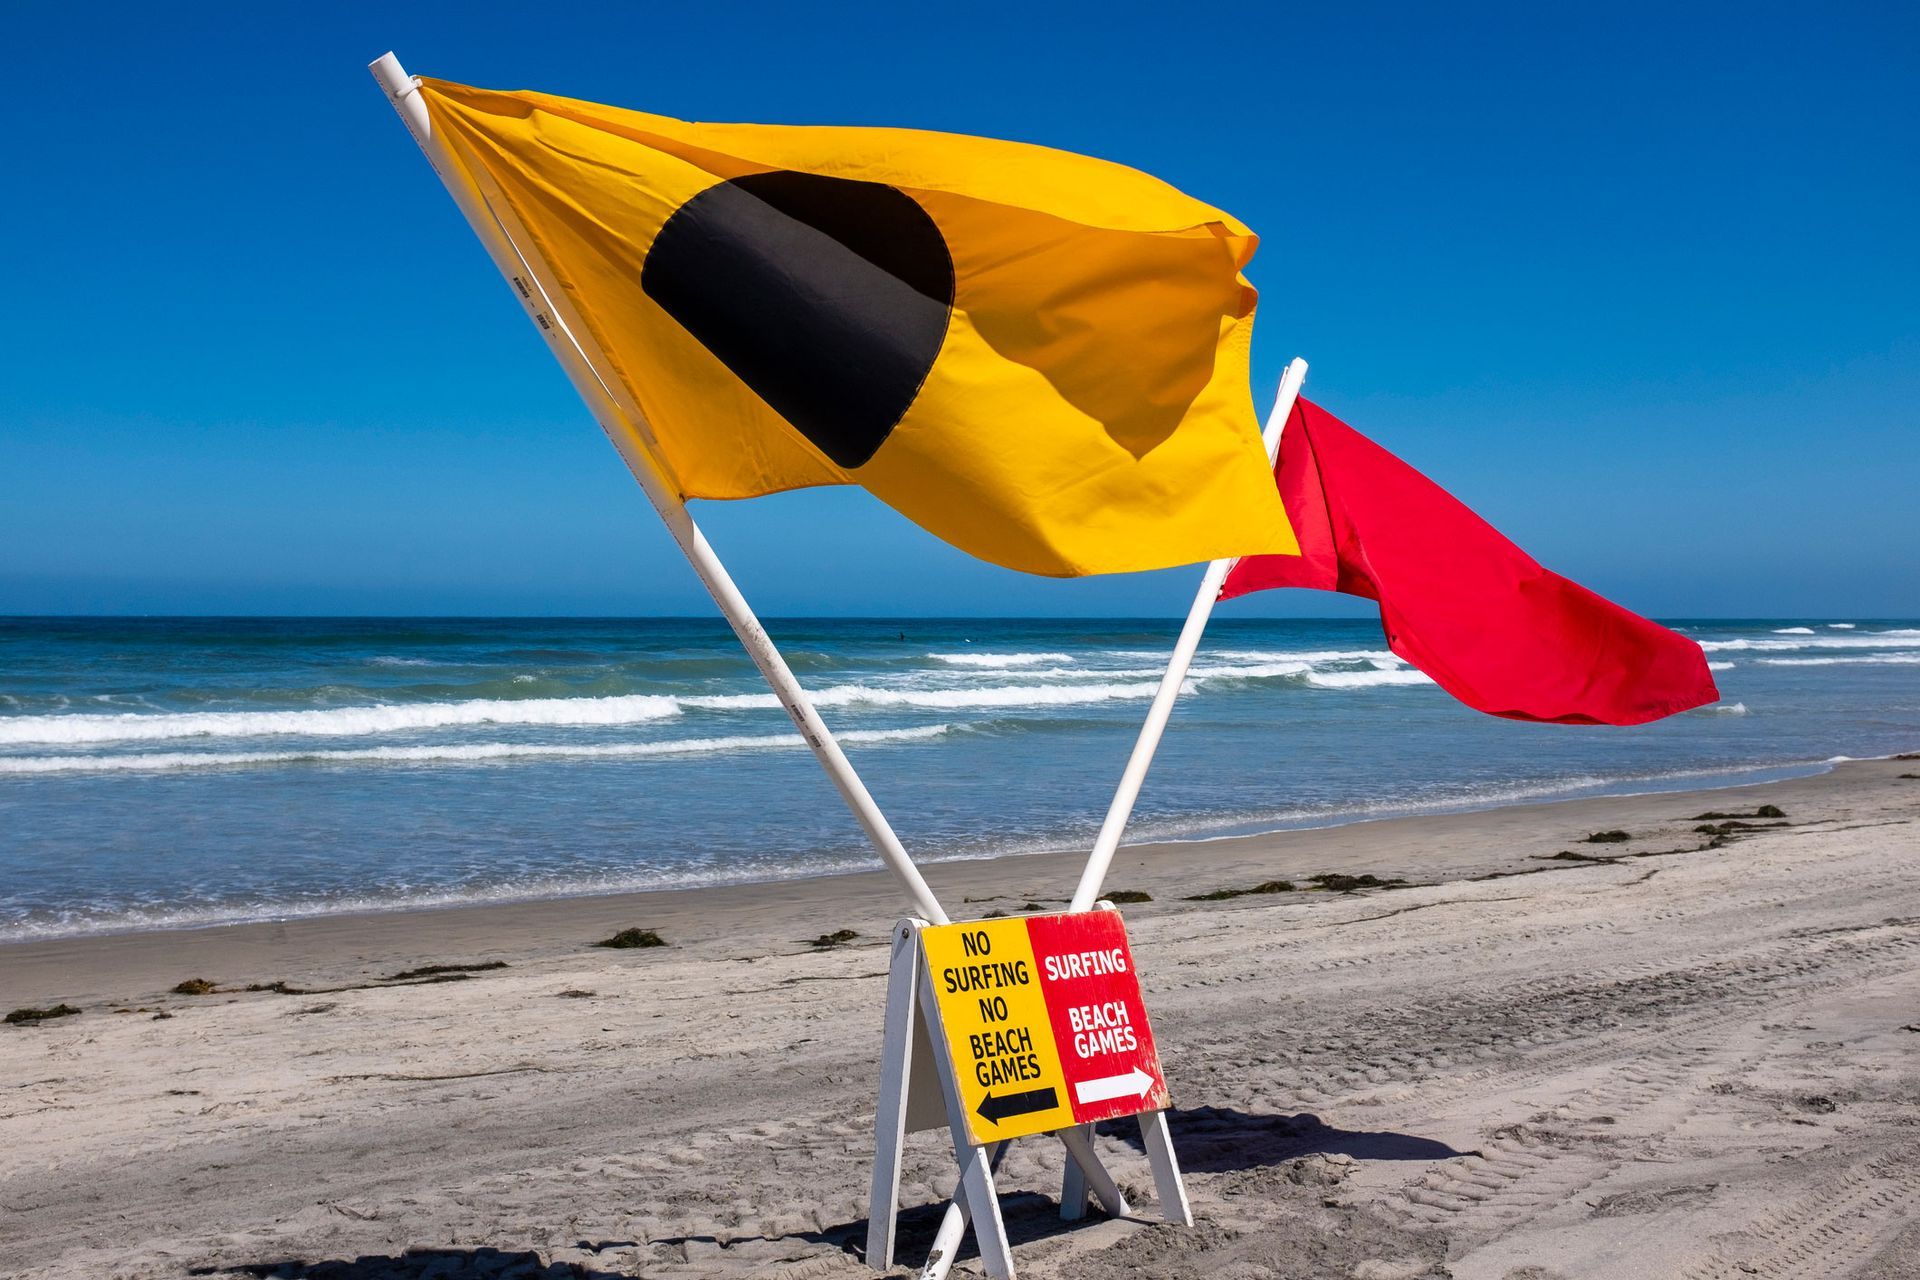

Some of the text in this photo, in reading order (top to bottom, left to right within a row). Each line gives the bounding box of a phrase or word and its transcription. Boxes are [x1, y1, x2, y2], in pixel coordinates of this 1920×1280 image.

[961, 931, 991, 957] NO
[943, 960, 1030, 993] SURFING
[1044, 948, 1127, 981] SURFING
[978, 996, 1008, 1023] NO
[1068, 1000, 1130, 1033] BEACH
[970, 1027, 1033, 1059] BEACH
[1074, 1026, 1137, 1059] GAMES
[975, 1053, 1041, 1087] GAMES
